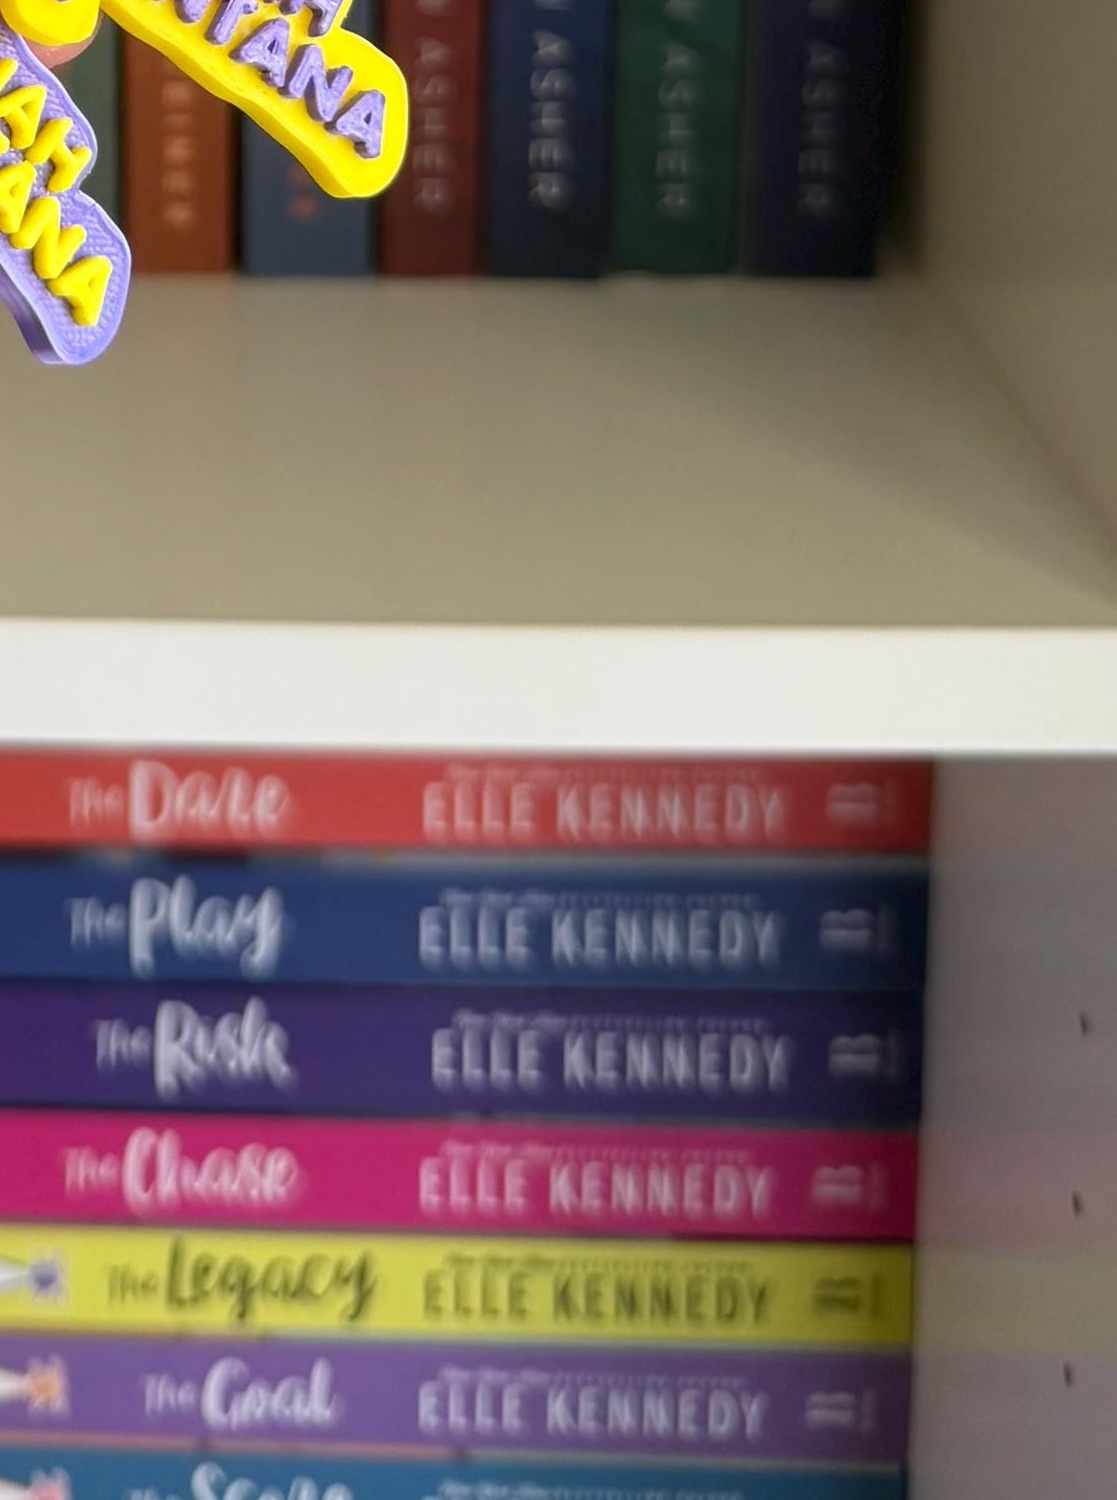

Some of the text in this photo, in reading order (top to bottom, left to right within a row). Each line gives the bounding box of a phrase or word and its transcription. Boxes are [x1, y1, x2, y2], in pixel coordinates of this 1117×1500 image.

[413, 36, 454, 215] ASHER
[529, 29, 572, 209] ASHER
[655, 44, 700, 218] ASHER
[65, 759, 292, 843] The Dare
[424, 781, 786, 842] ELLE KENNEDY
[68, 874, 292, 978] The Play
[419, 905, 780, 971] ELLE KENNEDY
[95, 1018, 151, 1072] The
[432, 1028, 793, 1093] ELLE KENNEDY
[64, 1126, 300, 1212] The Chase
[419, 1156, 776, 1217] ELLE KENNEDY
[165, 1234, 377, 1323] Legacy
[424, 1268, 774, 1325] ELLE KENNEDY
[200, 1357, 340, 1429] Goal
[419, 1380, 768, 1440] ELLE KENNEDY
